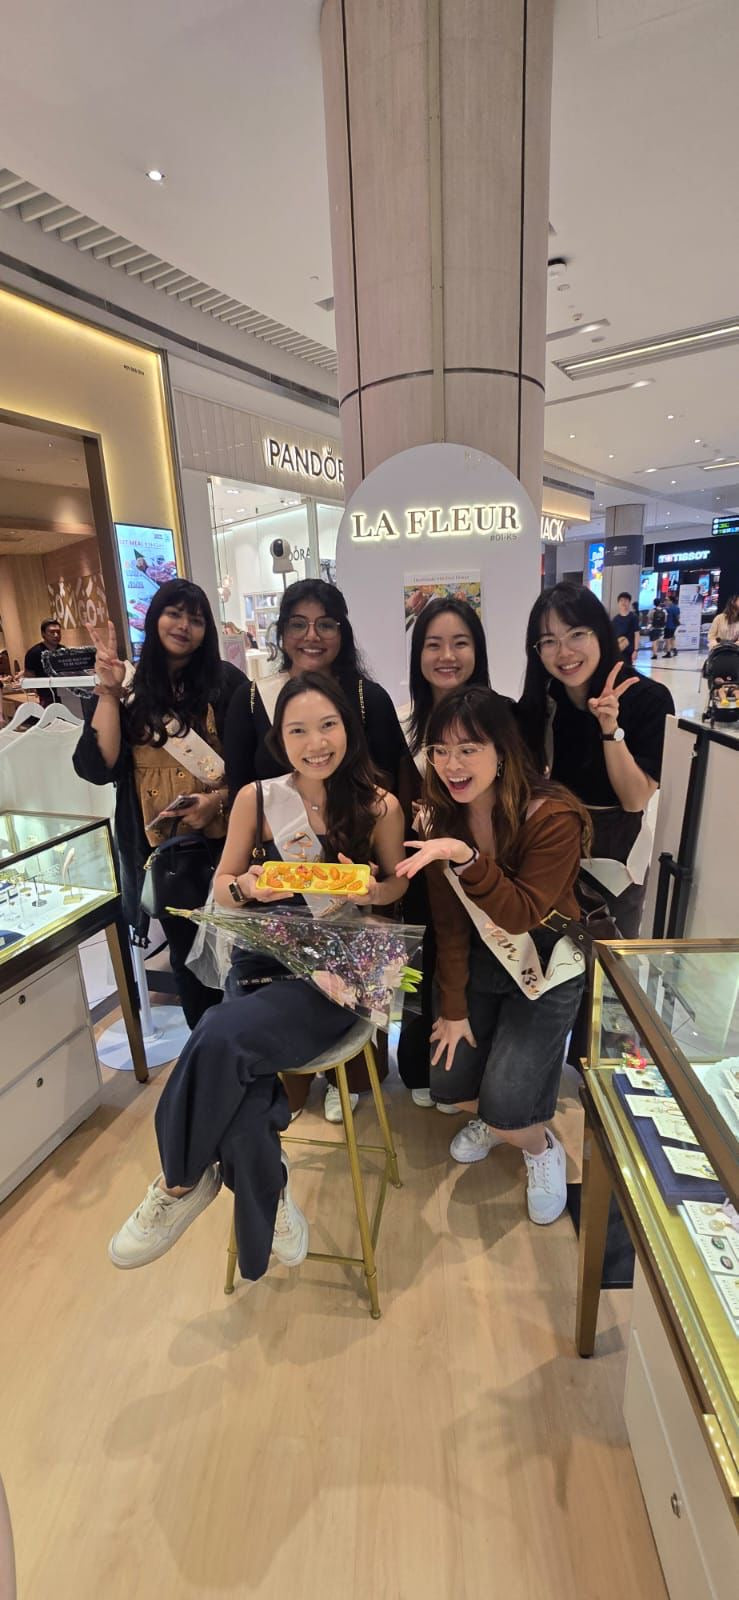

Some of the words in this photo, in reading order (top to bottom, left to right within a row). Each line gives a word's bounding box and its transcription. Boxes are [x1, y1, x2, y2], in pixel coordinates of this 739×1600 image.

[352, 511, 397, 538] LA
[407, 504, 519, 535] FLEUR
[672, 550, 711, 562] TISSOT
